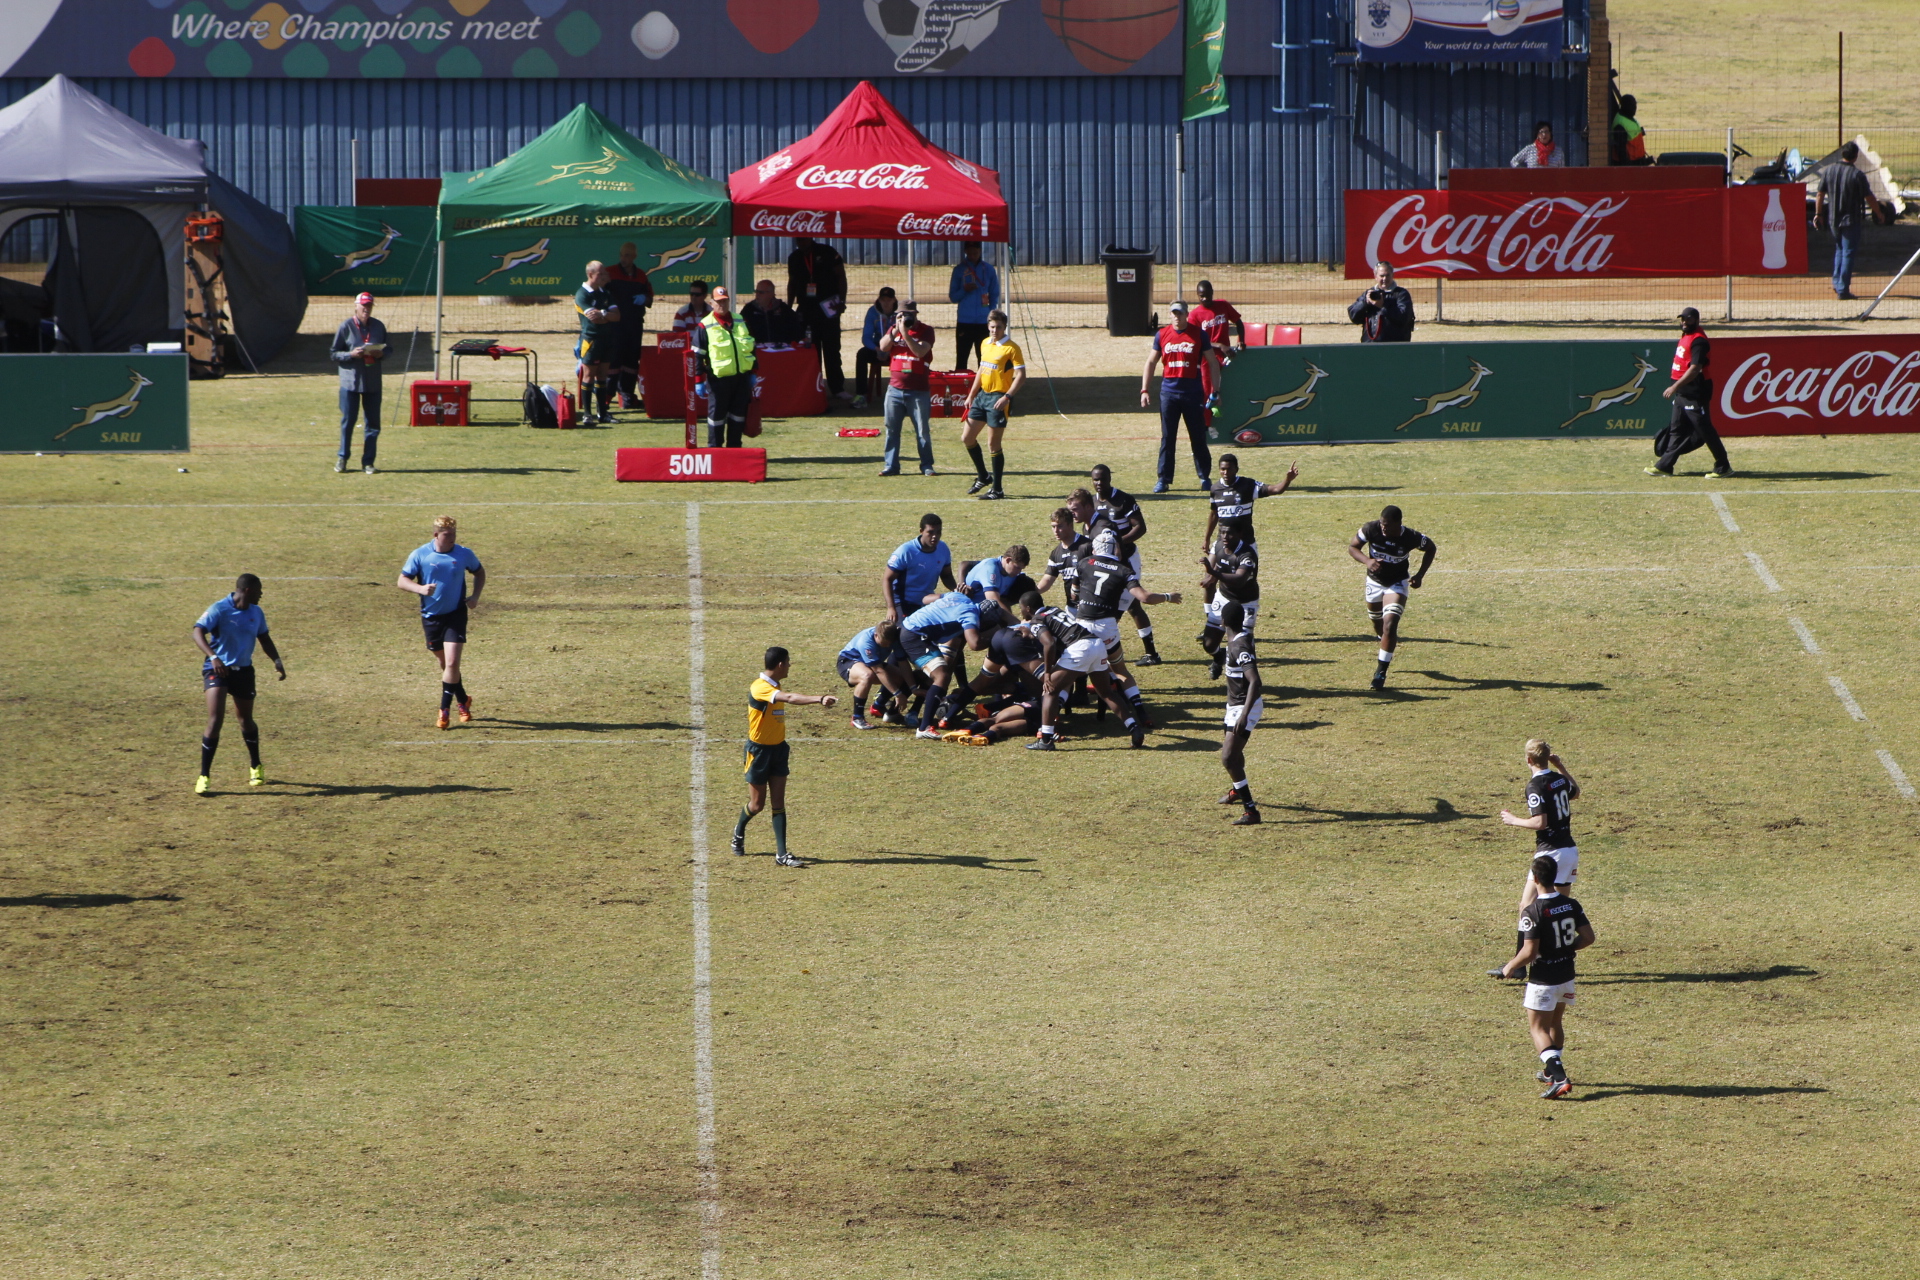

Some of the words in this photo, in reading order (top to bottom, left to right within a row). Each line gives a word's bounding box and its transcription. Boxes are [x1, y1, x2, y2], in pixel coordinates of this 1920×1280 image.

[172, 14, 270, 40] Where
[280, 13, 453, 48] Champions
[461, 16, 542, 40] meet
[1425, 41, 1444, 50] Your
[1446, 41, 1470, 50] world
[1473, 42, 1482, 50] to
[1493, 41, 1519, 50] better
[1521, 40, 1548, 49] future
[796, 163, 930, 189] Coca-Cola
[455, 218, 509, 229] BECOME
[514, 218, 521, 227] A
[524, 215, 579, 227] REFEREE
[594, 215, 717, 227] SAREFEREES.CO.ZA
[750, 209, 828, 233] Coca-Cola
[897, 212, 974, 236] Coca-Cola
[1365, 194, 1629, 272] Coca-Cola
[352, 277, 365, 285] SA
[367, 277, 404, 285] RUGBY
[509, 277, 523, 285] SA
[526, 277, 562, 285] RUGBY
[667, 276, 680, 284] SA
[683, 275, 719, 283] RUGBY
[659, 338, 685, 349] Coca-Cola
[1164, 342, 1195, 354] Coca-Cola
[1721, 351, 1920, 419] Coca-Cola
[1277, 424, 1317, 435] SARU
[1441, 422, 1481, 433] SARU
[1605, 419, 1645, 430] SARU
[100, 432, 141, 443] SARU
[669, 454, 712, 475] 50M
[1094, 570, 1110, 596] 7
[1553, 789, 1570, 820] 10
[1552, 917, 1576, 948] 13
